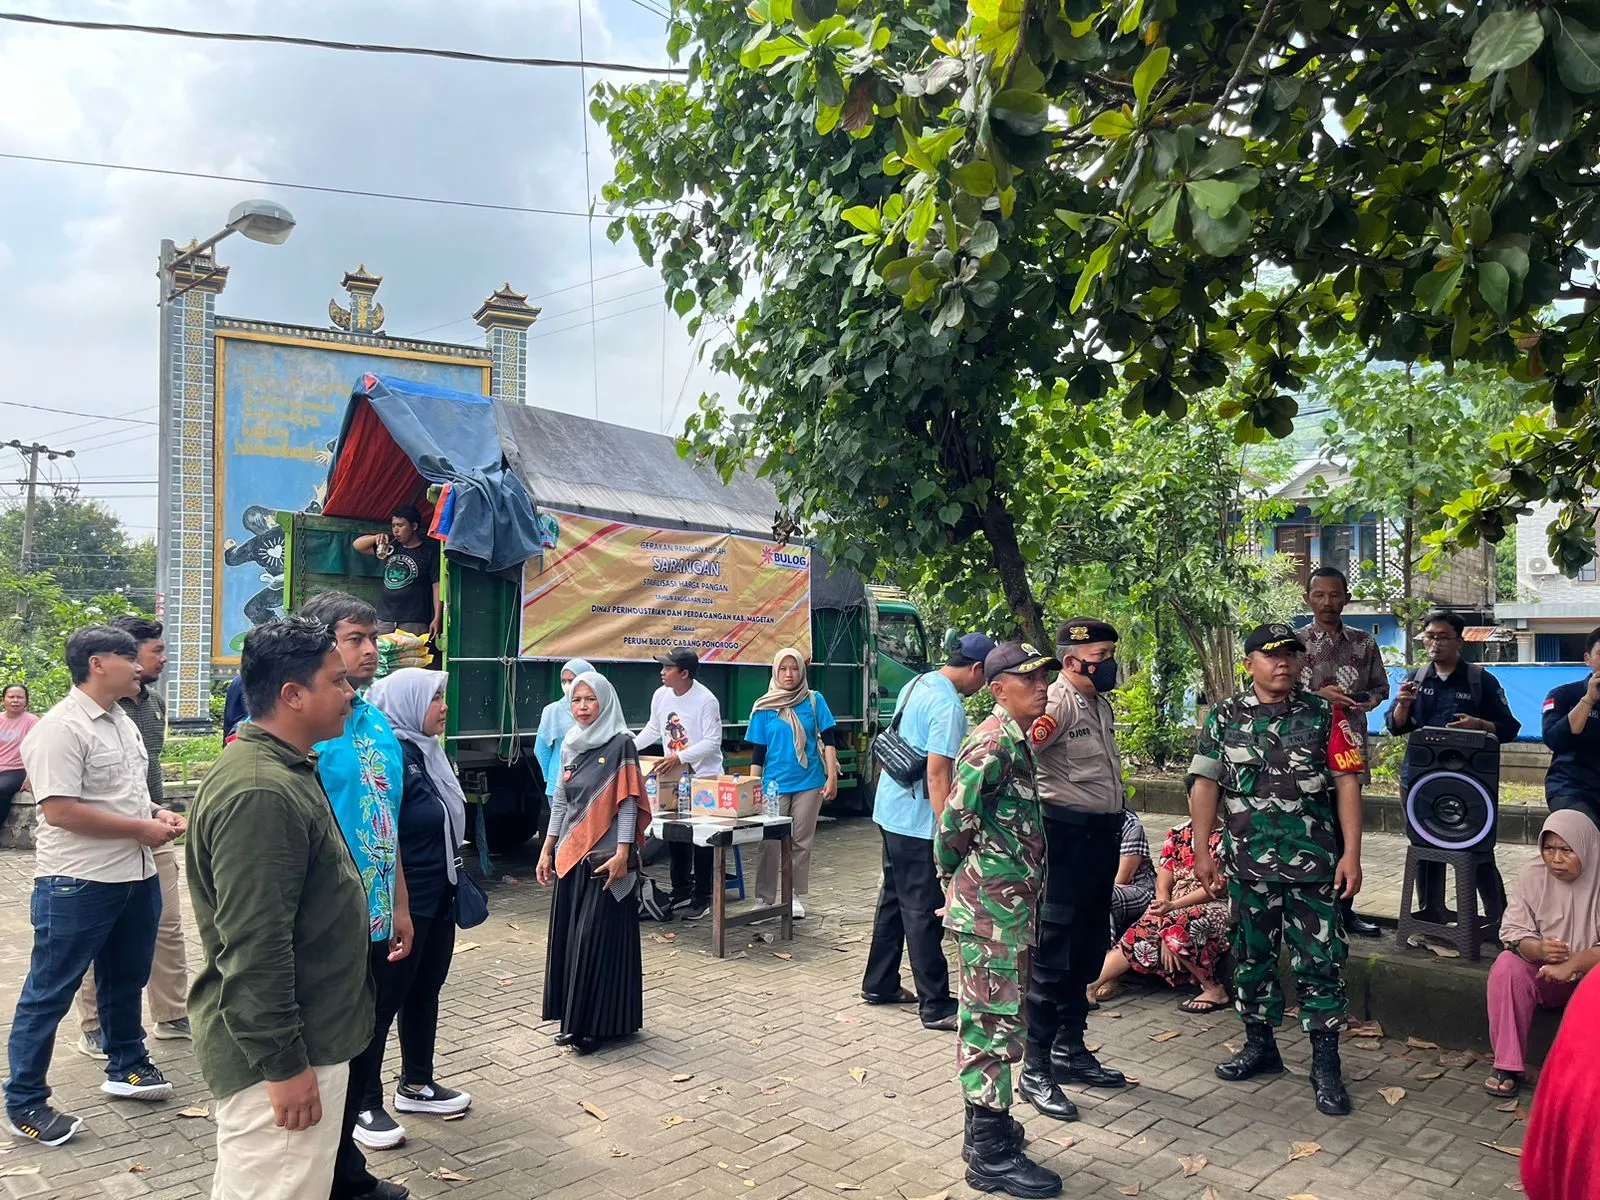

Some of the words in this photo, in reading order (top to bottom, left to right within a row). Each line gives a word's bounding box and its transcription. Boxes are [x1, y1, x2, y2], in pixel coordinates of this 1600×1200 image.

[640, 541, 673, 552] GERAKAN
[674, 544, 704, 553] PANGAN
[774, 552, 806, 566] BULOG
[653, 556, 720, 577] SARANGAN
[679, 580, 700, 589] HARGA
[701, 582, 728, 592] PANGAN
[673, 595, 701, 603] ANGGARAN
[592, 604, 611, 613] DINAS
[612, 606, 665, 616] PERINDUSTRIAN
[667, 609, 682, 617] DAN
[683, 610, 732, 620] PERDAGANGAN
[747, 616, 774, 624] MAGETAN
[623, 636, 647, 645] PERUM
[649, 637, 671, 646] BULOG
[673, 639, 700, 647] CABANG
[702, 640, 739, 649] PONOROGO
[1069, 727, 1090, 739] DJOKO
[721, 791, 733, 801] 48
